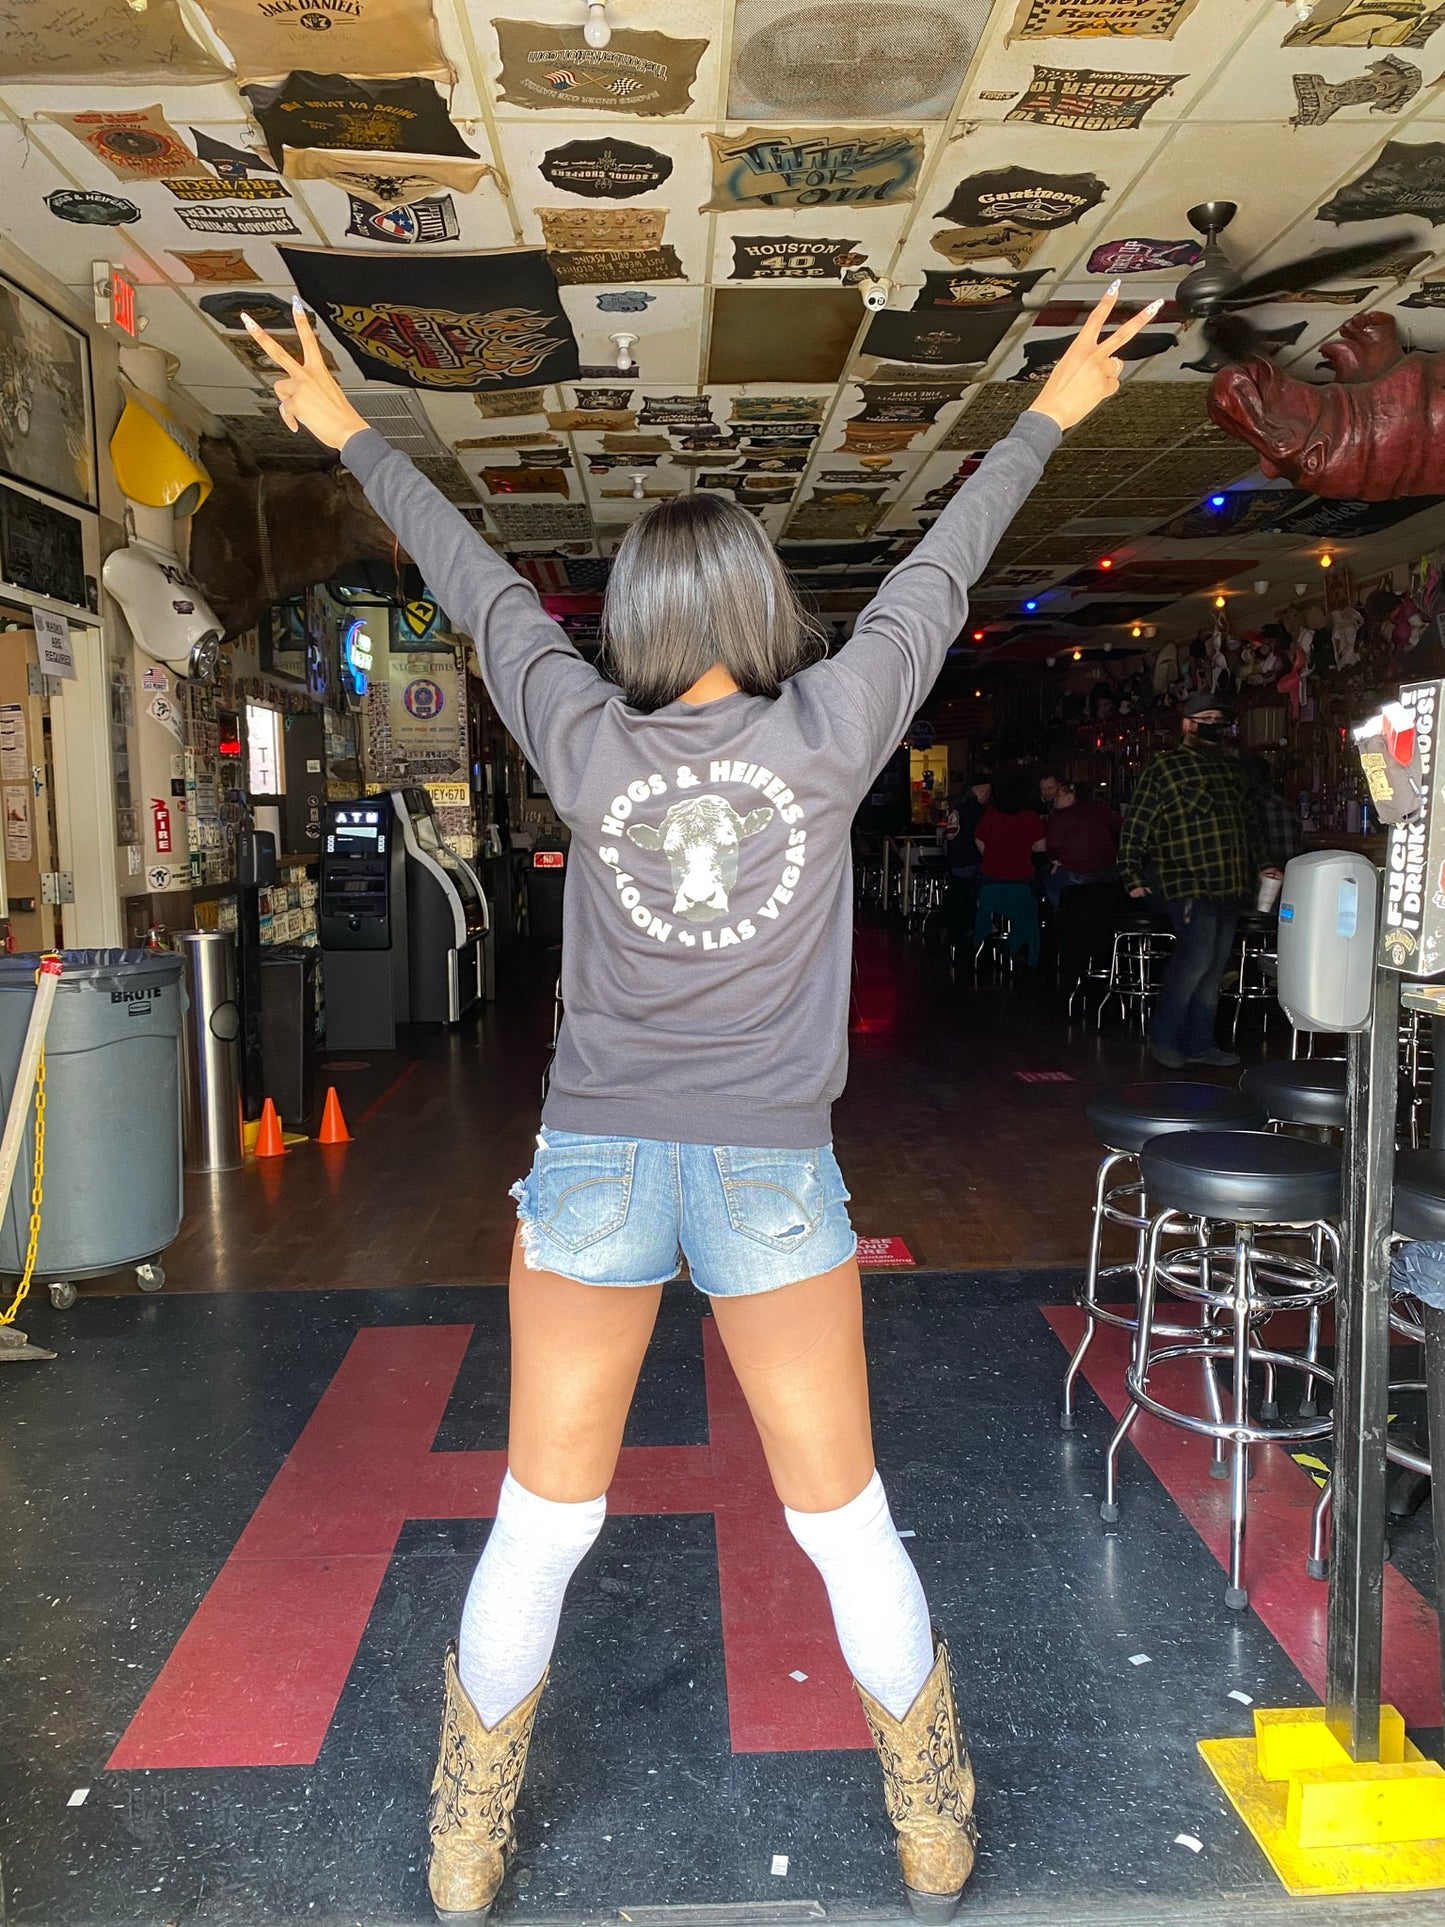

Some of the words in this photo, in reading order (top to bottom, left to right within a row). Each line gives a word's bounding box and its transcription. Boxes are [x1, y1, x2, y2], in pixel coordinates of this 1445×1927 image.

[258, 0, 297, 17] JACK
[298, 0, 364, 17] DANIEL'S
[1056, 8, 1158, 19] Racing
[1066, 20, 1138, 30] Team
[1028, 80, 1058, 93] 10
[1060, 81, 1164, 97] LADDER
[580, 95, 618, 105] UNDER
[304, 100, 345, 110] WHAT
[349, 101, 369, 111] YA
[372, 102, 418, 120] BRUNG
[1010, 110, 1037, 121] 10
[1043, 115, 1137, 130] ENGINE
[550, 168, 606, 179] CHOPPERS
[608, 171, 649, 181] SCHOOL
[780, 168, 856, 187] FOR
[167, 180, 278, 190] FIRE/RESCUE
[181, 190, 255, 200] MARQUE
[258, 190, 285, 199] LA
[85, 193, 130, 211] HEIFERS
[180, 206, 287, 220] FIREFIGHTERS
[188, 216, 238, 232] SPRINGS
[239, 217, 295, 233] COLORADO
[408, 204, 445, 242] PRIDE
[743, 243, 841, 257] HOUSTON
[571, 252, 606, 265] ASKING
[616, 259, 643, 270] WEAR
[645, 256, 667, 267] JUST
[760, 256, 815, 269] 40
[556, 264, 595, 275] CLOTHES
[598, 262, 614, 272] BIG
[752, 268, 825, 277] FIRE
[112, 271, 135, 338] EXIT
[600, 773, 668, 838] HOGS
[676, 765, 703, 789] &
[709, 759, 805, 825] HEIFERS
[335, 811, 379, 824] ATM
[157, 811, 170, 850] FIRE
[1404, 823, 1427, 911] DRINK
[1387, 821, 1408, 927] FUCK
[599, 845, 673, 943] SOON
[702, 918, 757, 951] LAS
[756, 828, 807, 920] VEGAS
[111, 986, 162, 1004] BRUTE
